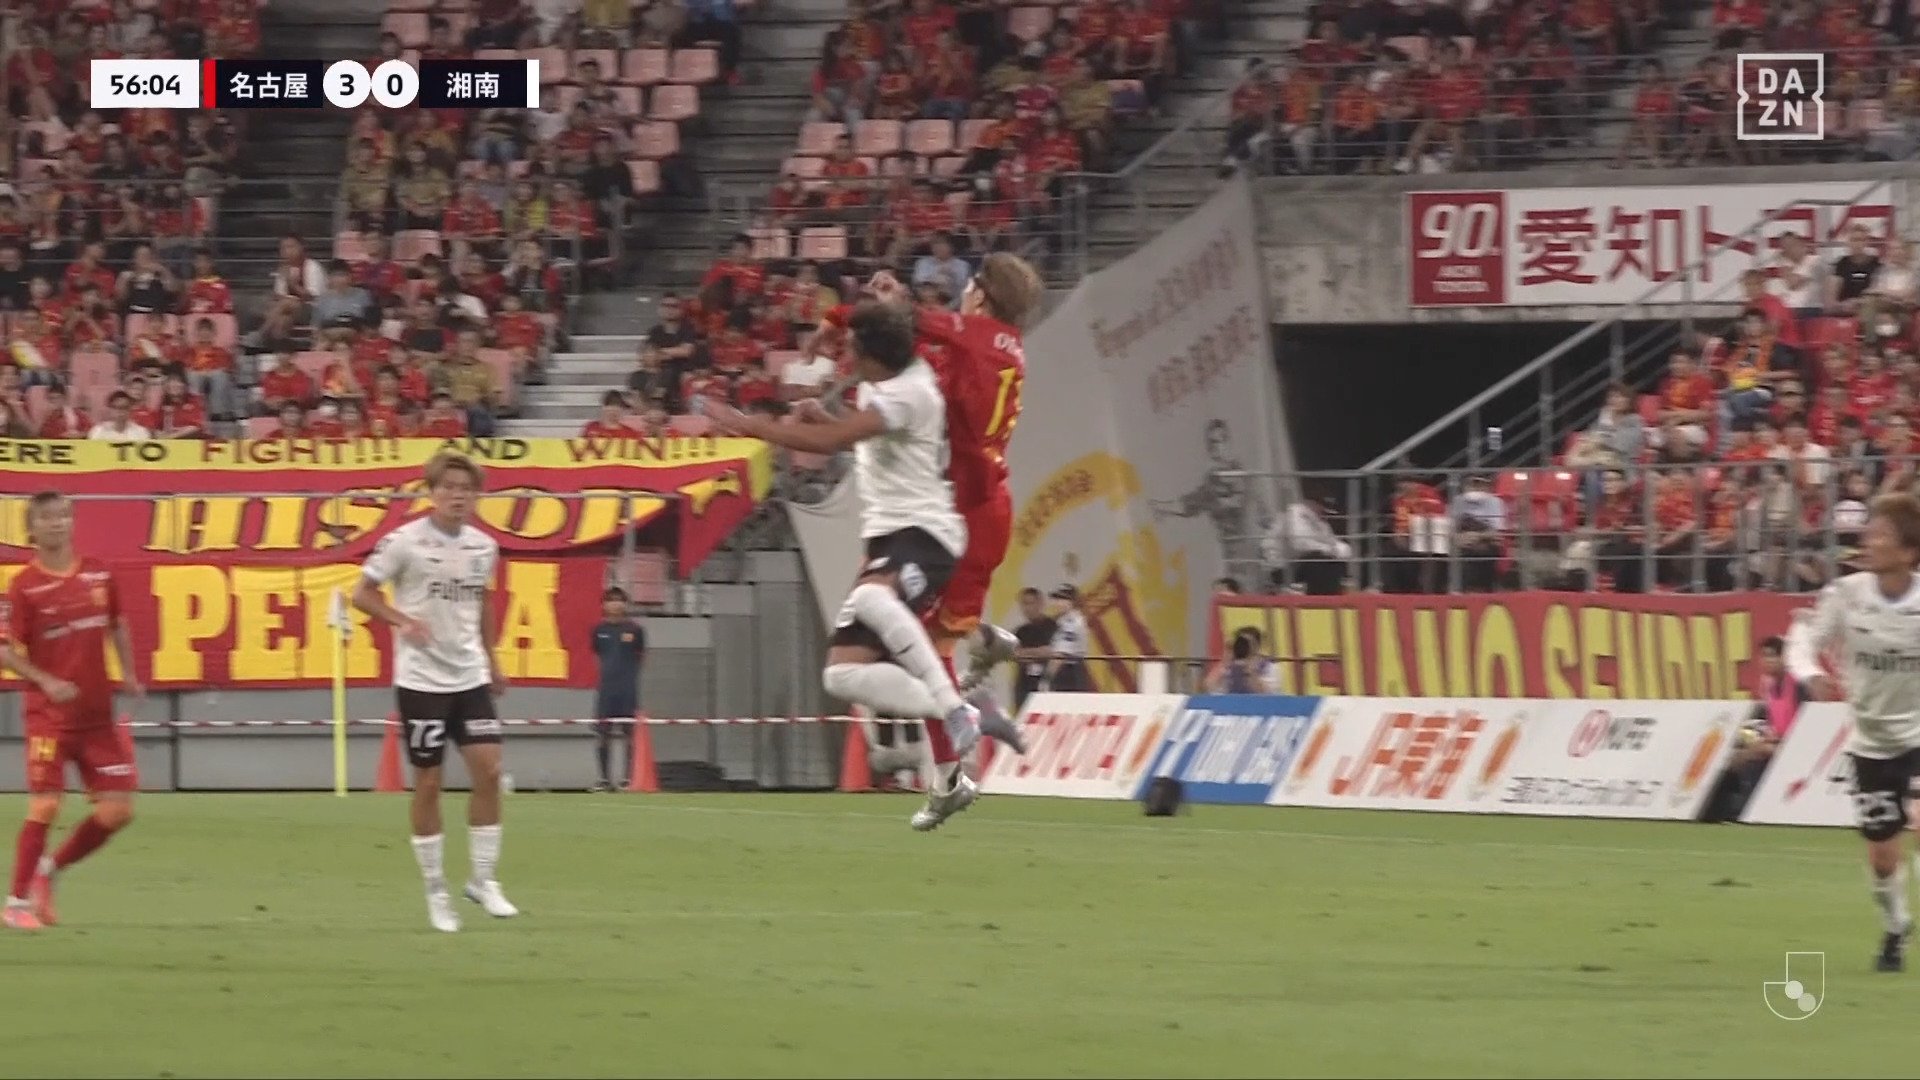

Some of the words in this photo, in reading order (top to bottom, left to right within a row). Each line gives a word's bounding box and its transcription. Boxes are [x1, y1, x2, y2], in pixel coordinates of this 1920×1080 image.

[109, 442, 168, 462] TO
[201, 438, 400, 464] FIGHT!!!
[566, 438, 716, 462] WIN!!!
[408, 719, 447, 749] 72
[996, 713, 1139, 778] TOYOTA
